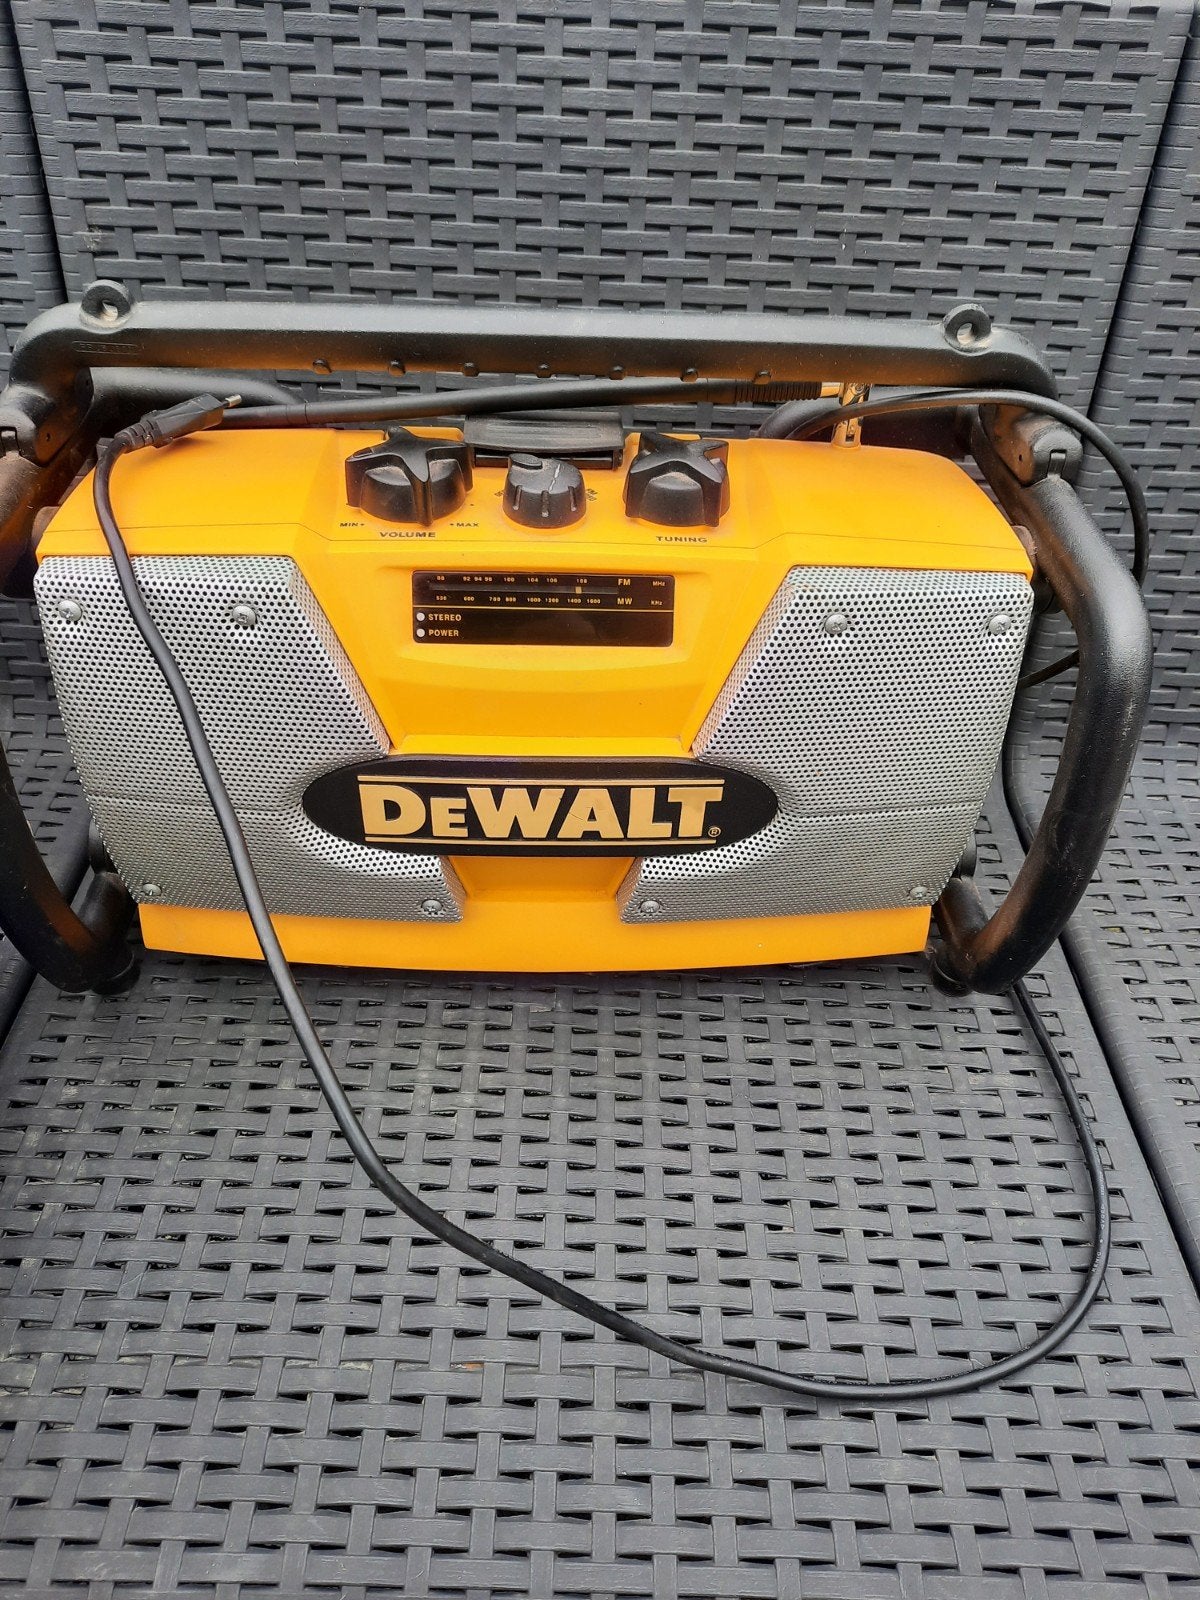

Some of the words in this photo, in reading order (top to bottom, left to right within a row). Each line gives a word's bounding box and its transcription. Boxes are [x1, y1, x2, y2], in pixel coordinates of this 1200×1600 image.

[655, 535, 708, 544] TUNING
[617, 578, 631, 586] FM
[617, 597, 633, 605] MW
[428, 613, 462, 622] STEREO
[428, 629, 460, 637] POWER
